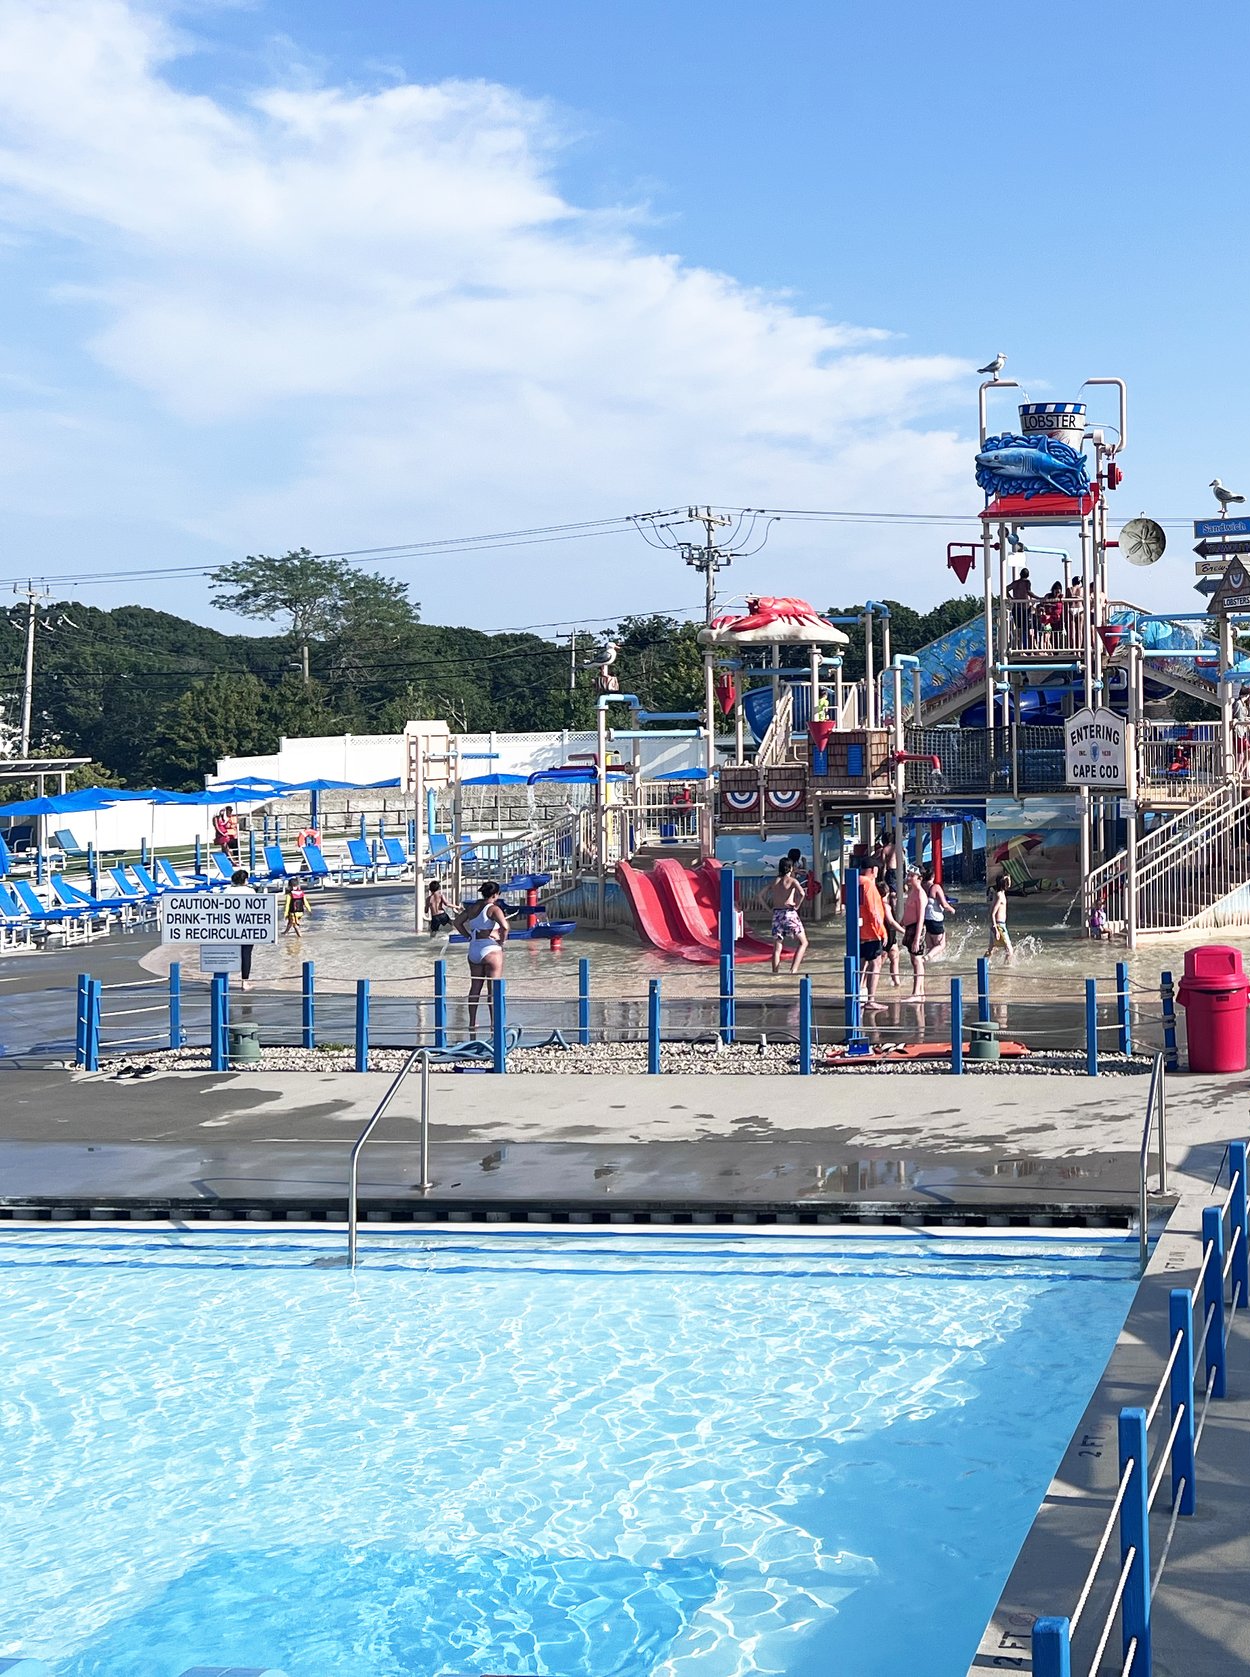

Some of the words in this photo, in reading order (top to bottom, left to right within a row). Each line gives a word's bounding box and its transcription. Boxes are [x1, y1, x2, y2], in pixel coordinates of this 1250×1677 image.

[1023, 414, 1076, 429] LOBSTER
[1202, 522, 1247, 534] Sandwich
[1223, 596, 1250, 606] LOBSTERS
[1070, 724, 1120, 747] ENTERING
[1073, 764, 1097, 778] CAPE
[1099, 764, 1119, 779] COD
[170, 898, 240, 910] CAUTION-DO
[245, 898, 268, 910] NOT
[166, 913, 231, 925] DRINK-THIS
[235, 913, 271, 925] WATER
[170, 928, 181, 940] IS
[185, 928, 268, 940] RECIRCULATED
[1080, 1434, 1106, 1447] FT
[1078, 1450, 1102, 1458] 2
[997, 1631, 1031, 1650] FT
[992, 1656, 1023, 1666] 2
